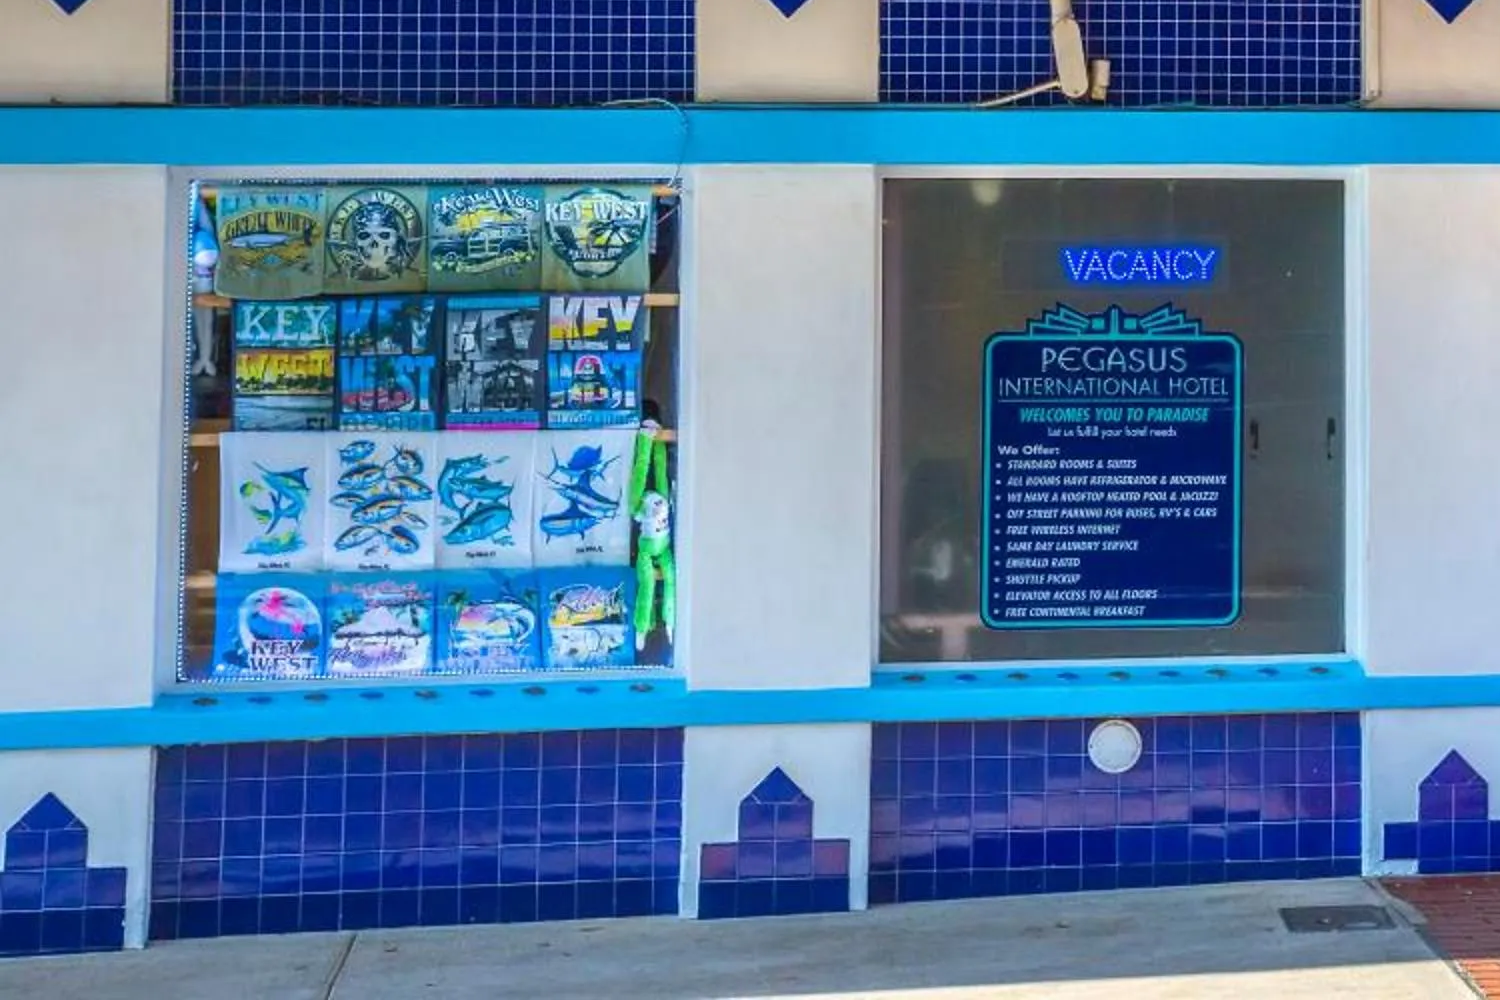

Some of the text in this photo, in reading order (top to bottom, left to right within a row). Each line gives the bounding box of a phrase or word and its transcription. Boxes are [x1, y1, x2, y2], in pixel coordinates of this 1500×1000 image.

[546, 201, 649, 221] KEY WEST
[1063, 248, 1216, 281] VACANCY
[236, 304, 331, 342] KEY
[549, 297, 641, 350] KEY
[1041, 346, 1187, 373] PEGASUS
[999, 377, 1229, 397] INTERNATIONAL HOTEL
[1019, 407, 1210, 423] WELCOMES YOU TO PARADISE
[1101, 429, 1123, 440] your
[1150, 426, 1177, 437] needs
[998, 445, 1061, 456] We Offer:
[1007, 459, 1057, 470] STANDARD
[1059, 459, 1094, 469] ROOMS
[1106, 459, 1138, 469] SUITES
[1006, 476, 1023, 486] ALL
[1026, 476, 1061, 486] ROOMS
[1063, 475, 1088, 486] HAVE
[1169, 475, 1227, 485] MICROWAVE
[1060, 492, 1105, 502] ROOFTOP
[1143, 492, 1168, 502] POOL
[1026, 509, 1058, 519] STREET
[1060, 509, 1103, 519] PARKING
[1105, 508, 1124, 518] FOR
[1193, 507, 1217, 517] CARS
[1006, 524, 1121, 535] FREE WIRELESS INTERNET
[1006, 542, 1032, 552] SAME
[1055, 541, 1100, 551] LAUNDRY
[1101, 540, 1139, 551] SERVICE
[1051, 557, 1081, 567] RATED
[1005, 573, 1081, 585] SHUTTLE PICKUP
[1005, 589, 1158, 601] ELEVATOR ACCESS TO ALL FLOORS
[1005, 606, 1146, 617] FREE CONTINENTAL BREAKFAST
[251, 640, 304, 655] KEY
[250, 656, 317, 672] WEST
